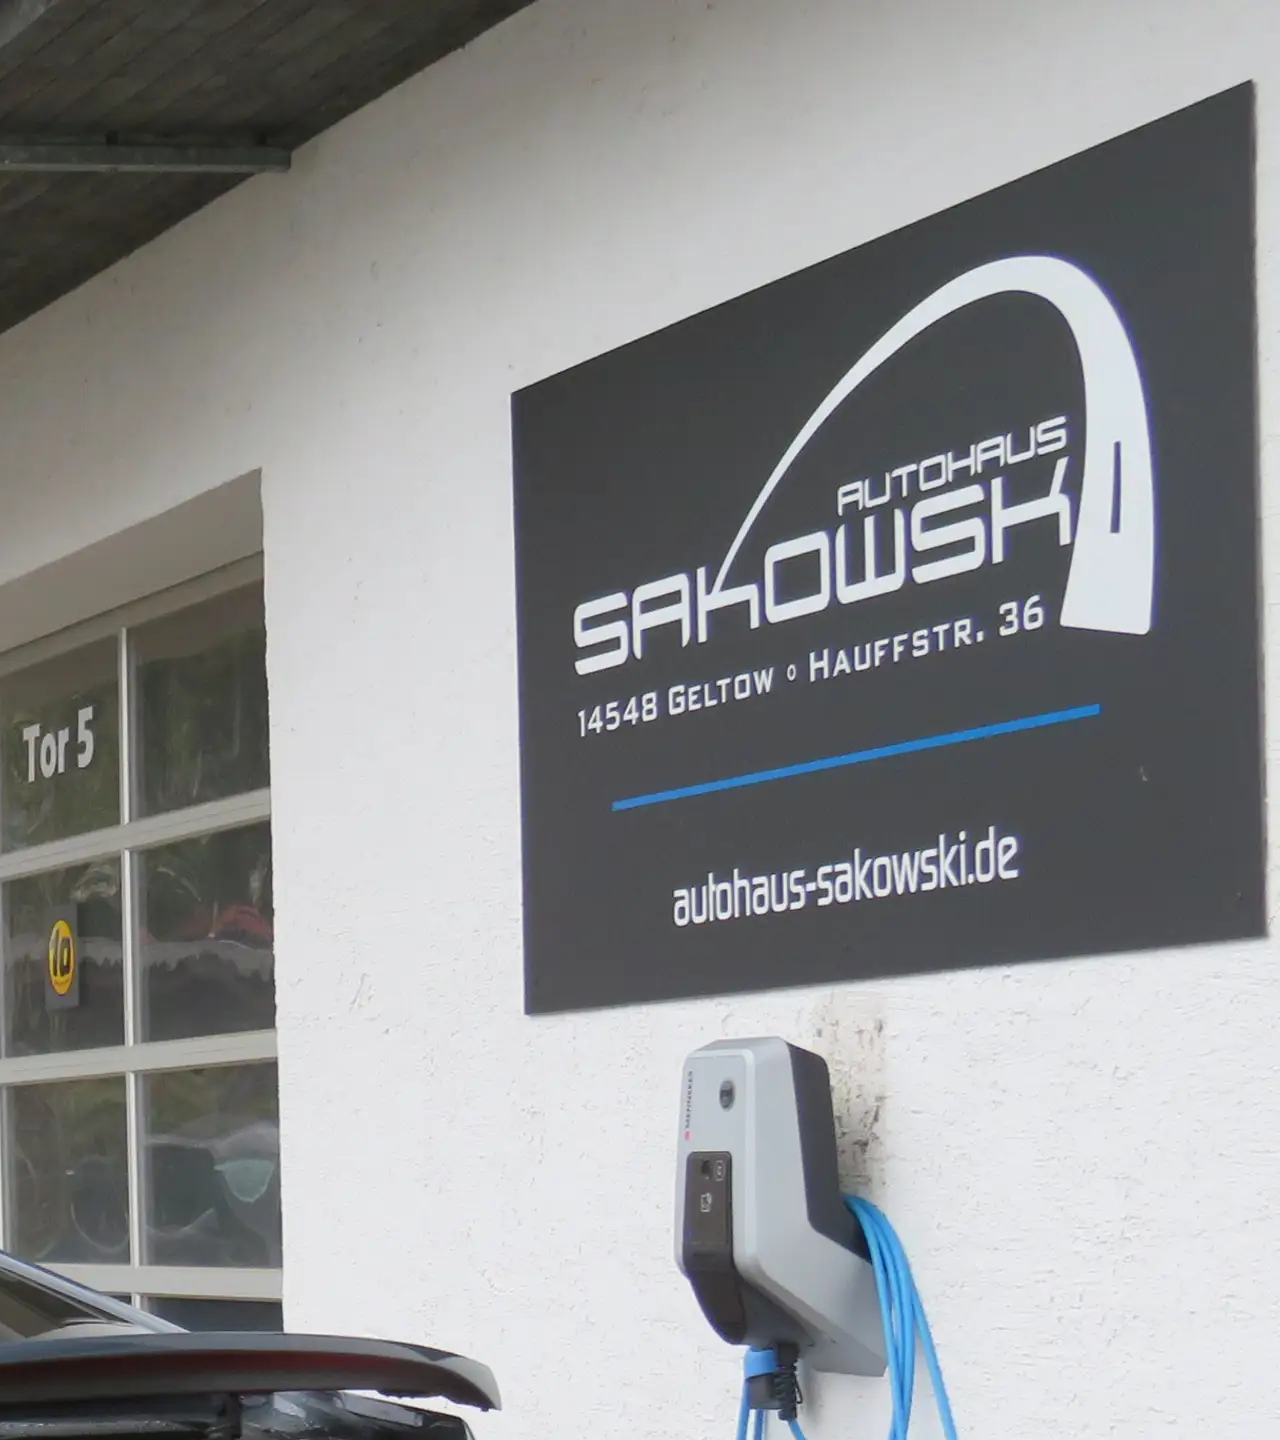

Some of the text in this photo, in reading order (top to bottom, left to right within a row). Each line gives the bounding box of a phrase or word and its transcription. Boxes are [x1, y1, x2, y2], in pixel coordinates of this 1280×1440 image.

[837, 415, 1068, 517] AUTOHAUS
[577, 696, 658, 737] 14548
[999, 594, 1045, 637] 36
[22, 705, 95, 784] Tor 5
[673, 825, 1019, 927] autohaus-sakowski.de
